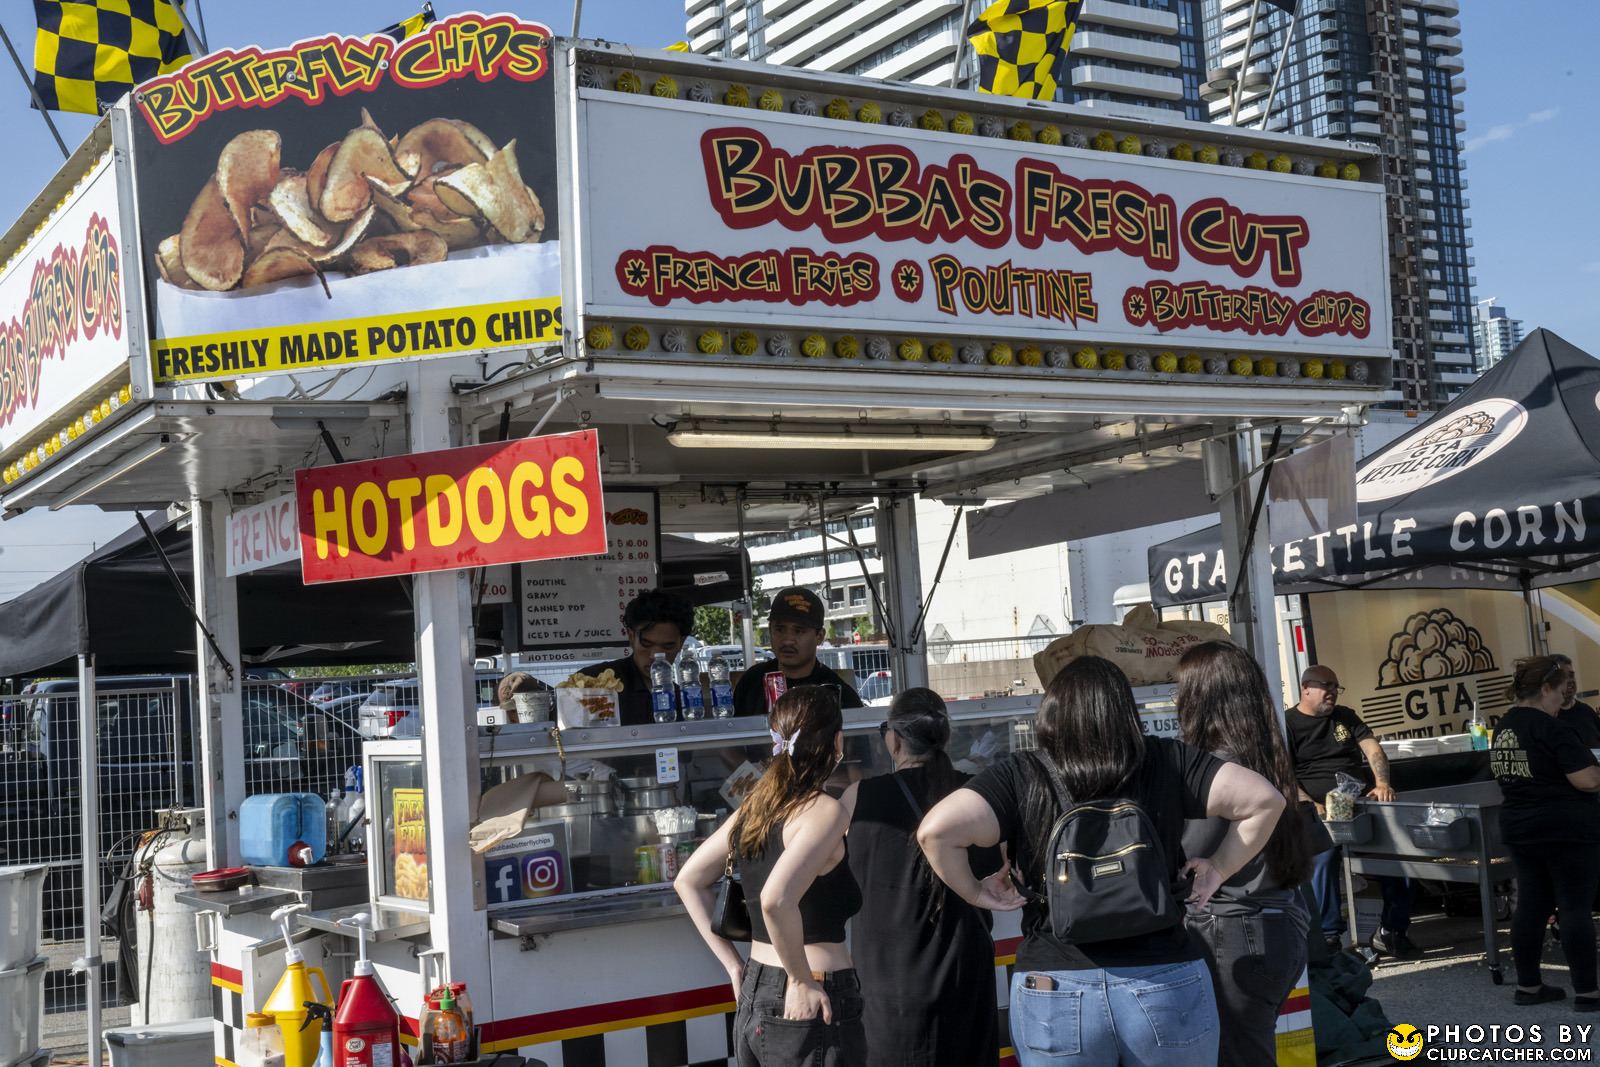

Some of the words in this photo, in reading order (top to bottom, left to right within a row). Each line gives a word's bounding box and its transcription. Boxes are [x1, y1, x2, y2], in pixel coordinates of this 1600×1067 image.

[144, 41, 389, 137] BUTTERFLY
[396, 22, 546, 81] CHIPS
[711, 136, 1006, 237] BUBBA'S
[1023, 167, 1172, 260] FRESH
[1188, 206, 1302, 276] CUT
[651, 252, 780, 295] FRENCH
[790, 254, 874, 297] FRIES
[931, 257, 1099, 329] POUTINE
[1150, 285, 1292, 327] BUTTERFLY
[1299, 296, 1366, 330] CHIPS
[158, 339, 270, 378] FRESHLY
[281, 328, 360, 366] MADE
[368, 316, 476, 356] POTATO
[485, 307, 563, 343] CHIPS
[1357, 460, 1424, 485] KETTLE
[1424, 446, 1487, 469] CORN
[1411, 439, 1461, 459] GTA
[312, 455, 590, 561] HOTDOGS
[1164, 548, 1228, 596] GTA
[1270, 517, 1418, 575] ETTLE
[1449, 498, 1588, 553] CORN
[527, 578, 567, 586] POUTINE
[527, 604, 565, 613] CANNED
[528, 618, 559, 626] WATER
[528, 631, 550, 639] ICED
[584, 629, 612, 637] JUICE
[528, 653, 575, 662] HOTDOGS
[1405, 682, 1474, 721] GTA
[1496, 750, 1516, 760] GTA
[1511, 761, 1533, 778] CORN
